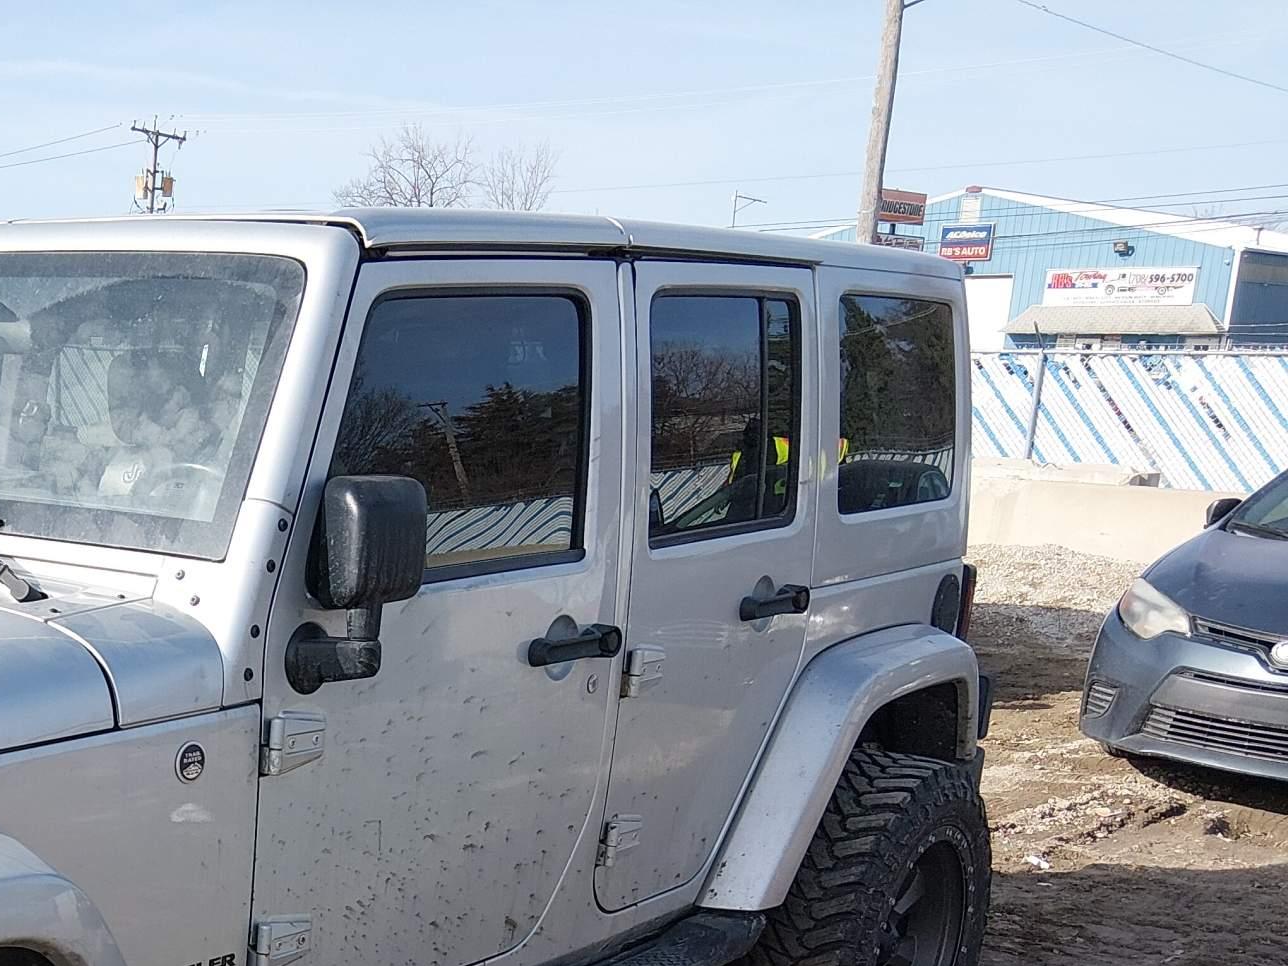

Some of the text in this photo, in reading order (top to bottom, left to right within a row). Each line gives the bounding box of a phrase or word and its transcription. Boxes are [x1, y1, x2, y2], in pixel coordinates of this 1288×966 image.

[880, 200, 924, 217] RIDGESTONE
[961, 246, 986, 255] AUTO
[1149, 273, 1194, 284] 596-5700
